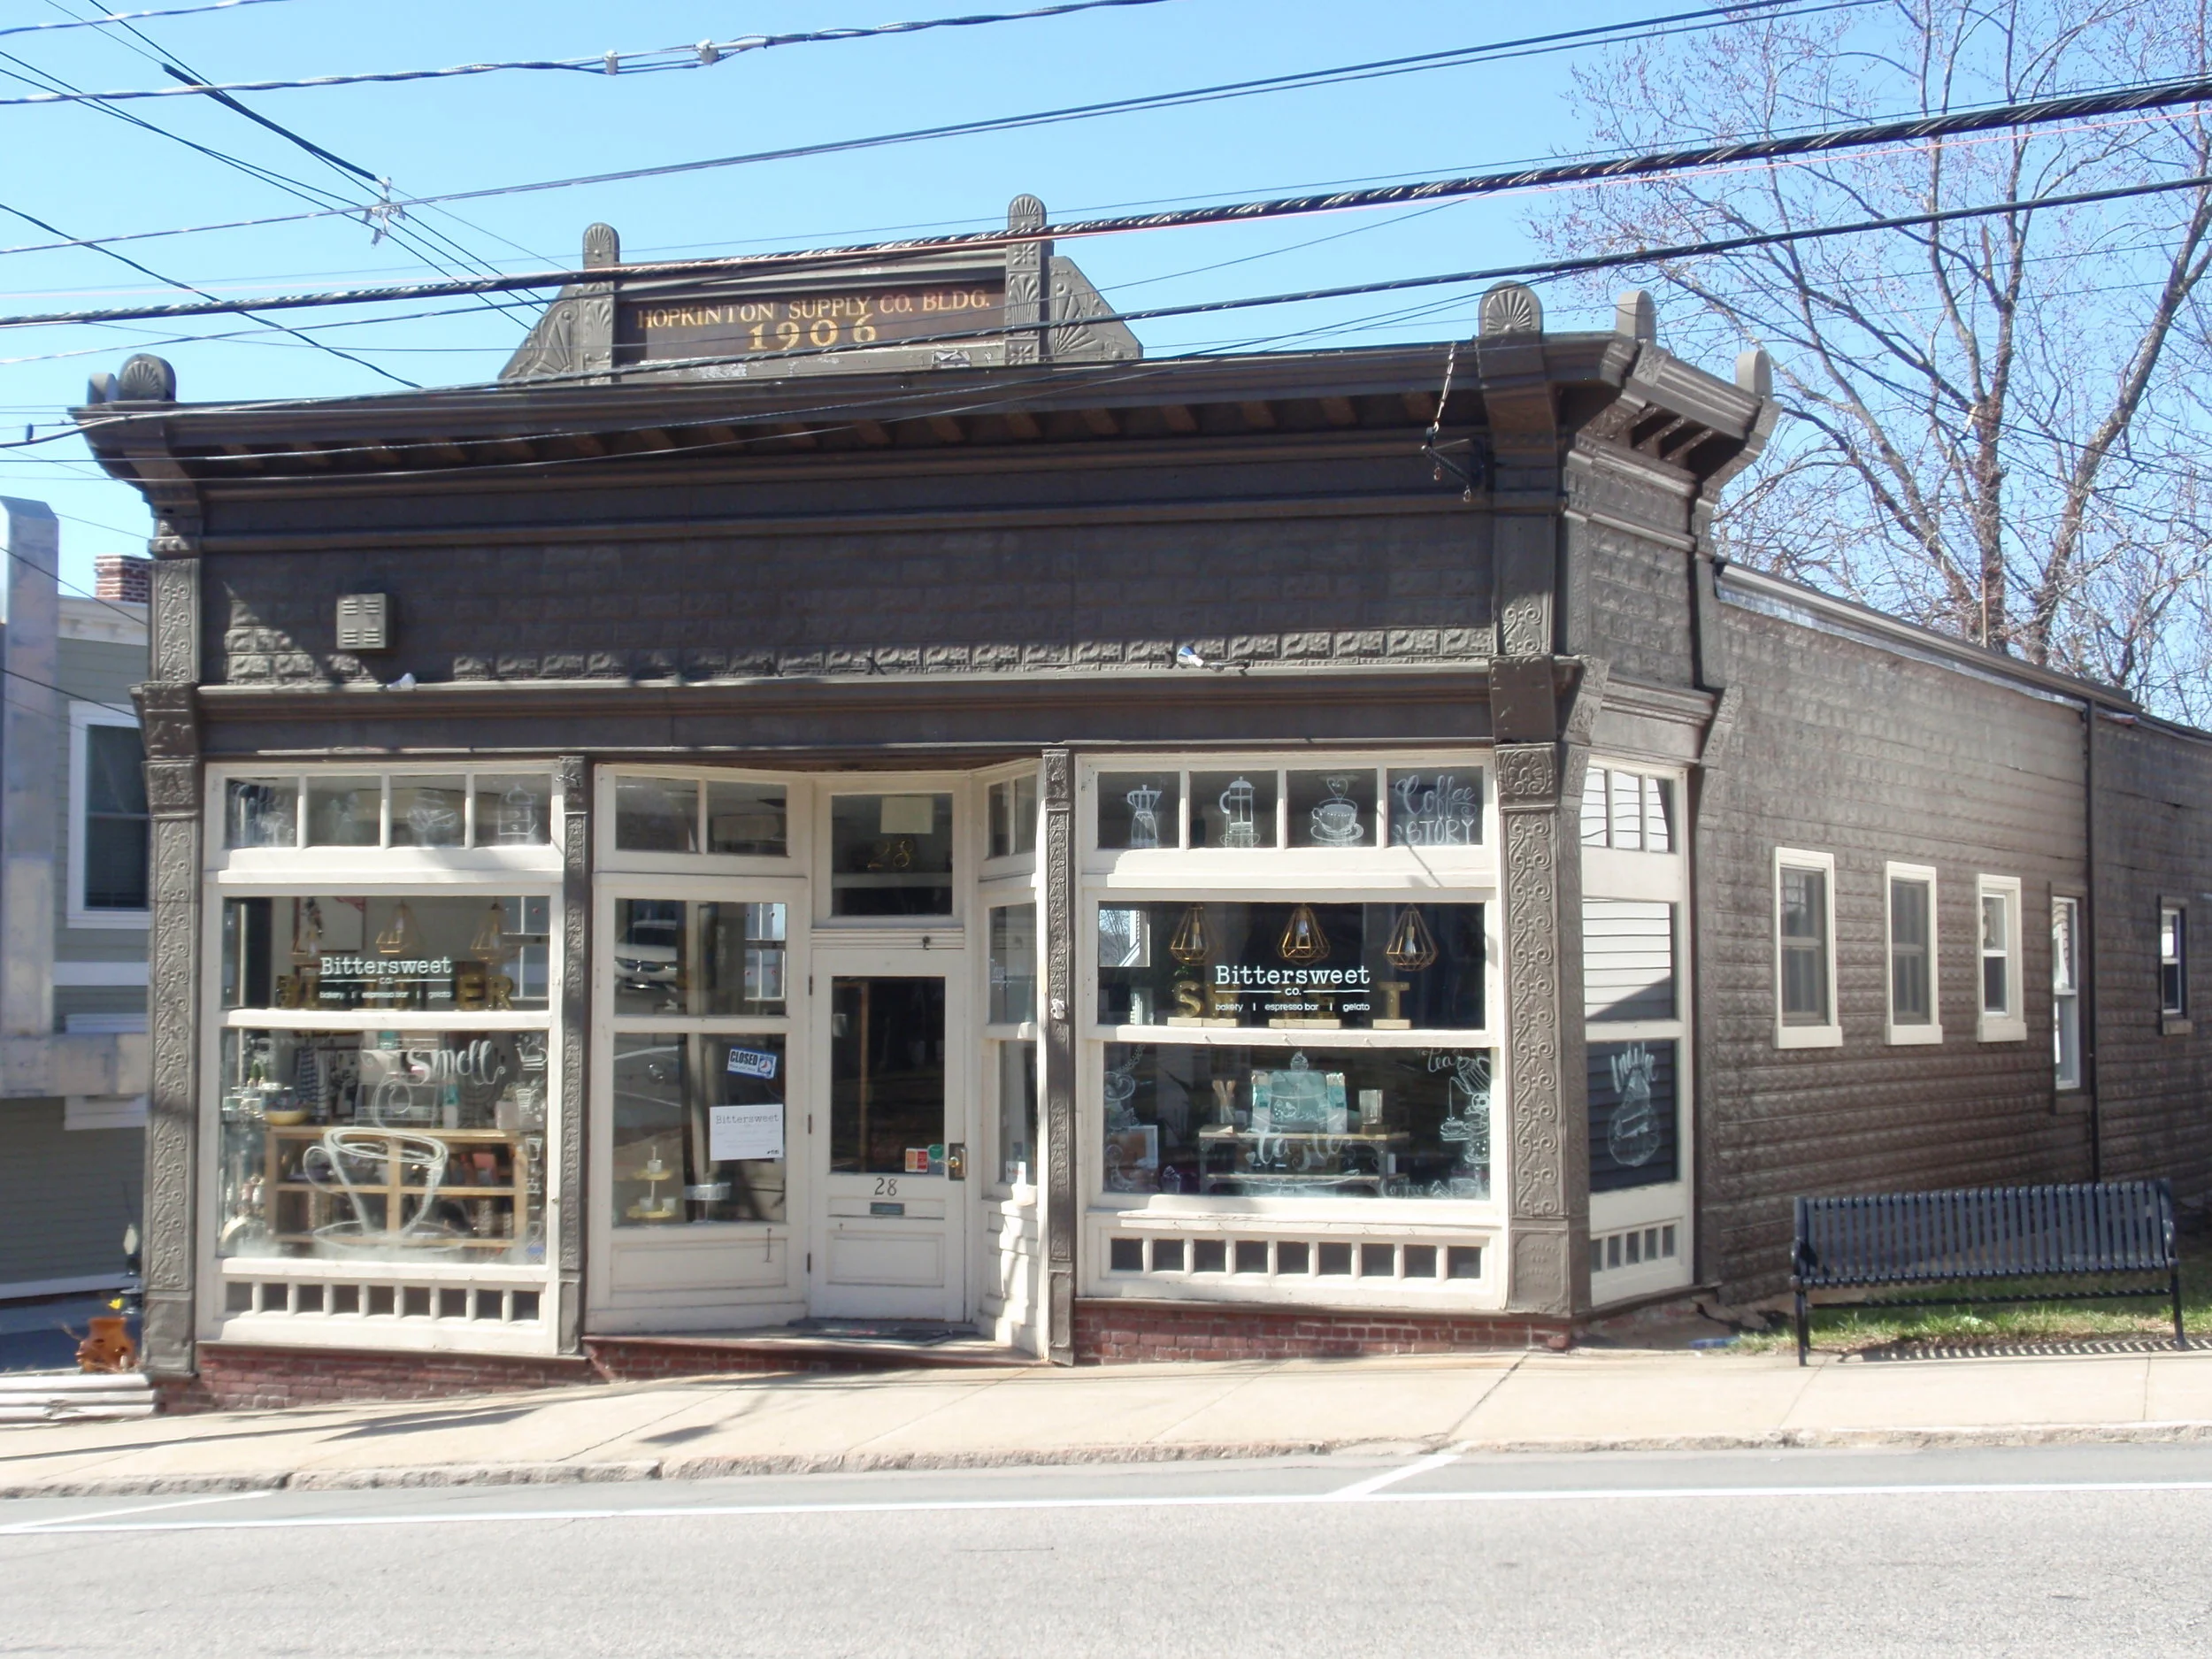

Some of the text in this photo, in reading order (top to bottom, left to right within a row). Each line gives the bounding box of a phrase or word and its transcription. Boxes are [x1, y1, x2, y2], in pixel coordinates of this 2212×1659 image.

[637, 289, 991, 329] HOPKINTON SUPPLY CO. BLDG.
[749, 313, 877, 351] 1906
[1395, 774, 1475, 821] Coffee
[1406, 819, 1475, 845] STORY
[867, 838, 915, 868] 28
[319, 956, 452, 974] Bittersweet
[1215, 964, 1371, 985] Bittersweet
[1215, 1002, 1371, 1012] bakery espresso bar gelato
[730, 1050, 758, 1065] CLOSED
[716, 1114, 780, 1125] Bittersweet
[874, 1177, 898, 1197] 28
